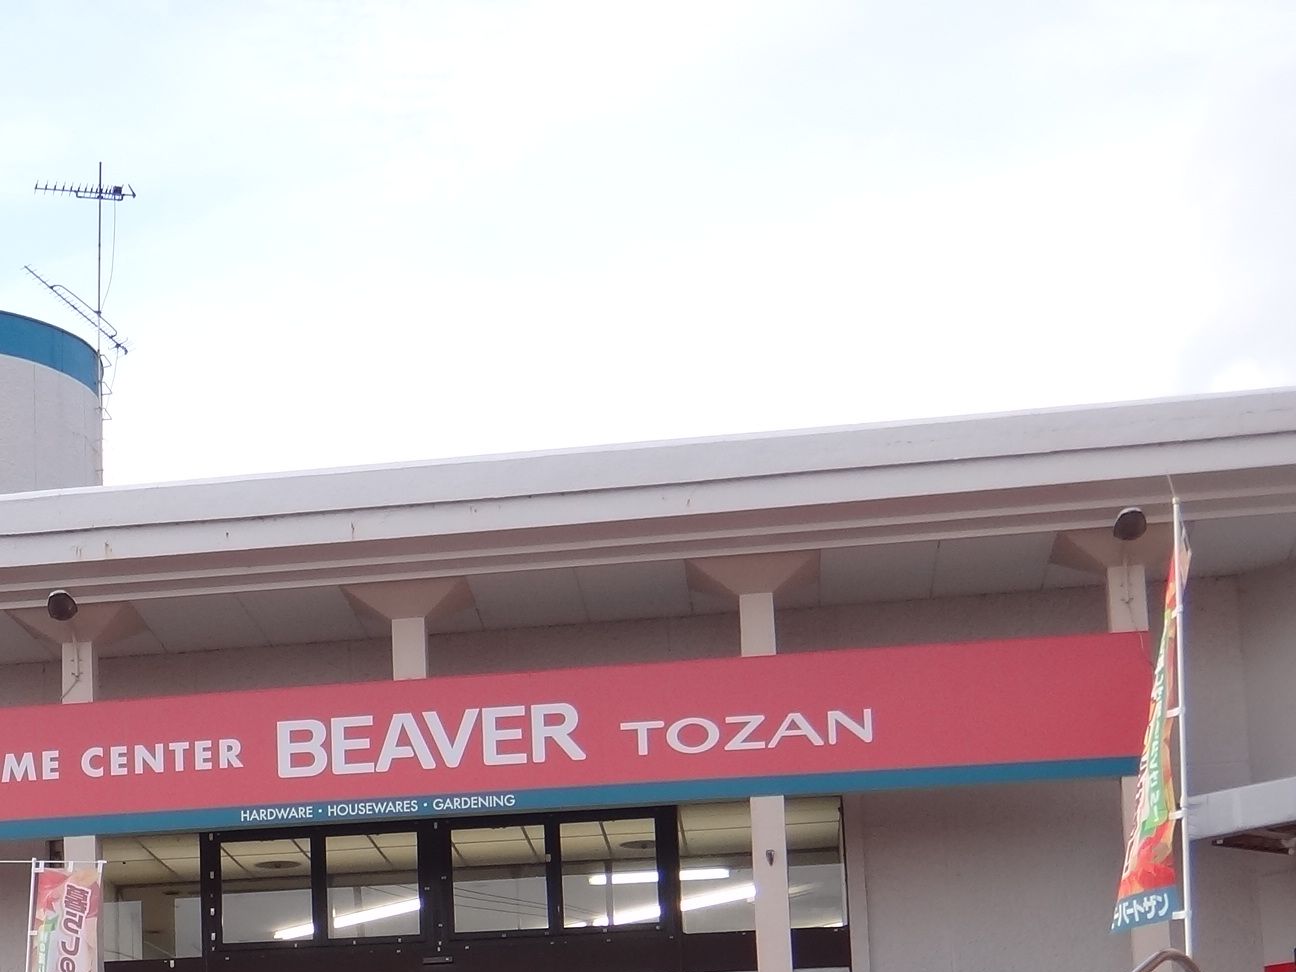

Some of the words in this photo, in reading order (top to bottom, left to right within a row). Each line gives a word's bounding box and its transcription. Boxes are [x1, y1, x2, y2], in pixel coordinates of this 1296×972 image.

[81, 738, 244, 777] CENTER
[277, 703, 586, 779] BEAVER
[621, 708, 873, 756] TOZAN
[240, 806, 313, 822] HARDWARE
[327, 800, 418, 817] HOUSEWARES
[433, 794, 515, 811] GARDENING
